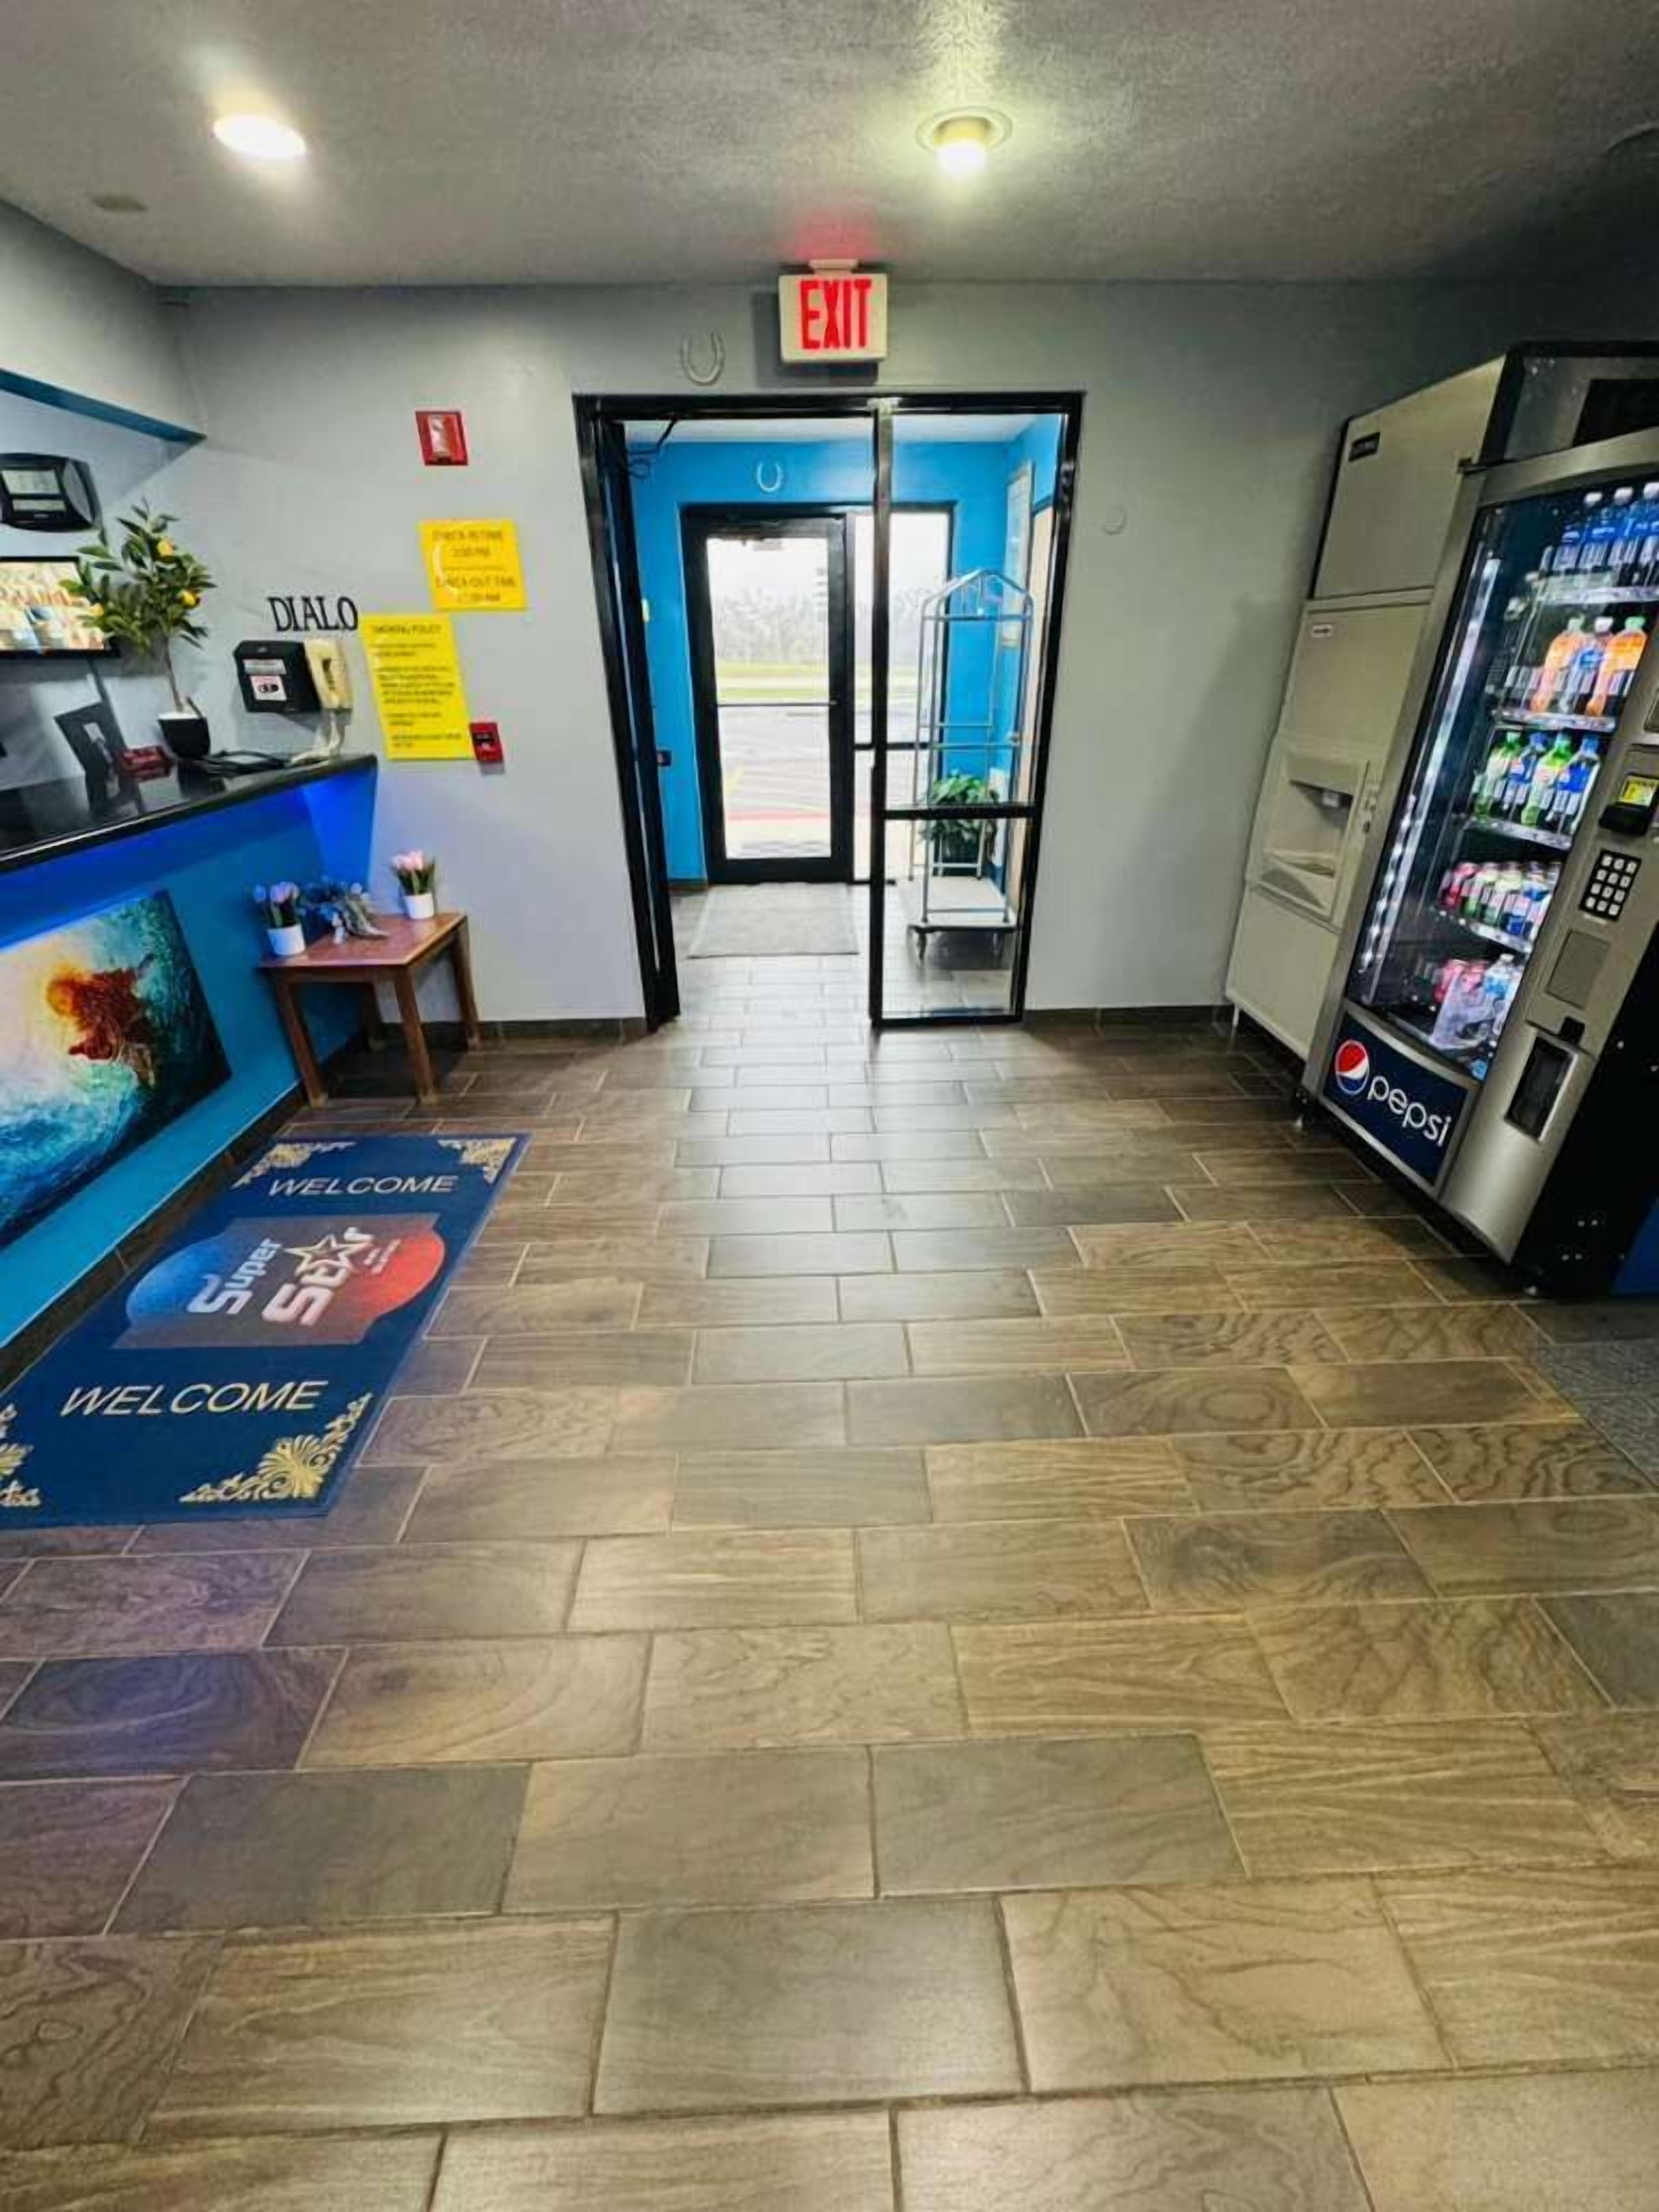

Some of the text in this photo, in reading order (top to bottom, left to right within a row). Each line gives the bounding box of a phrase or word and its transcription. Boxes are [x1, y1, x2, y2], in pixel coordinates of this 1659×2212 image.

[800, 279, 872, 349] EXIT
[1367, 1075, 1452, 1147] pepsi
[268, 1175, 458, 1197] WELCOME
[186, 1238, 284, 1315] Super
[60, 1380, 329, 1417] WELCOME
